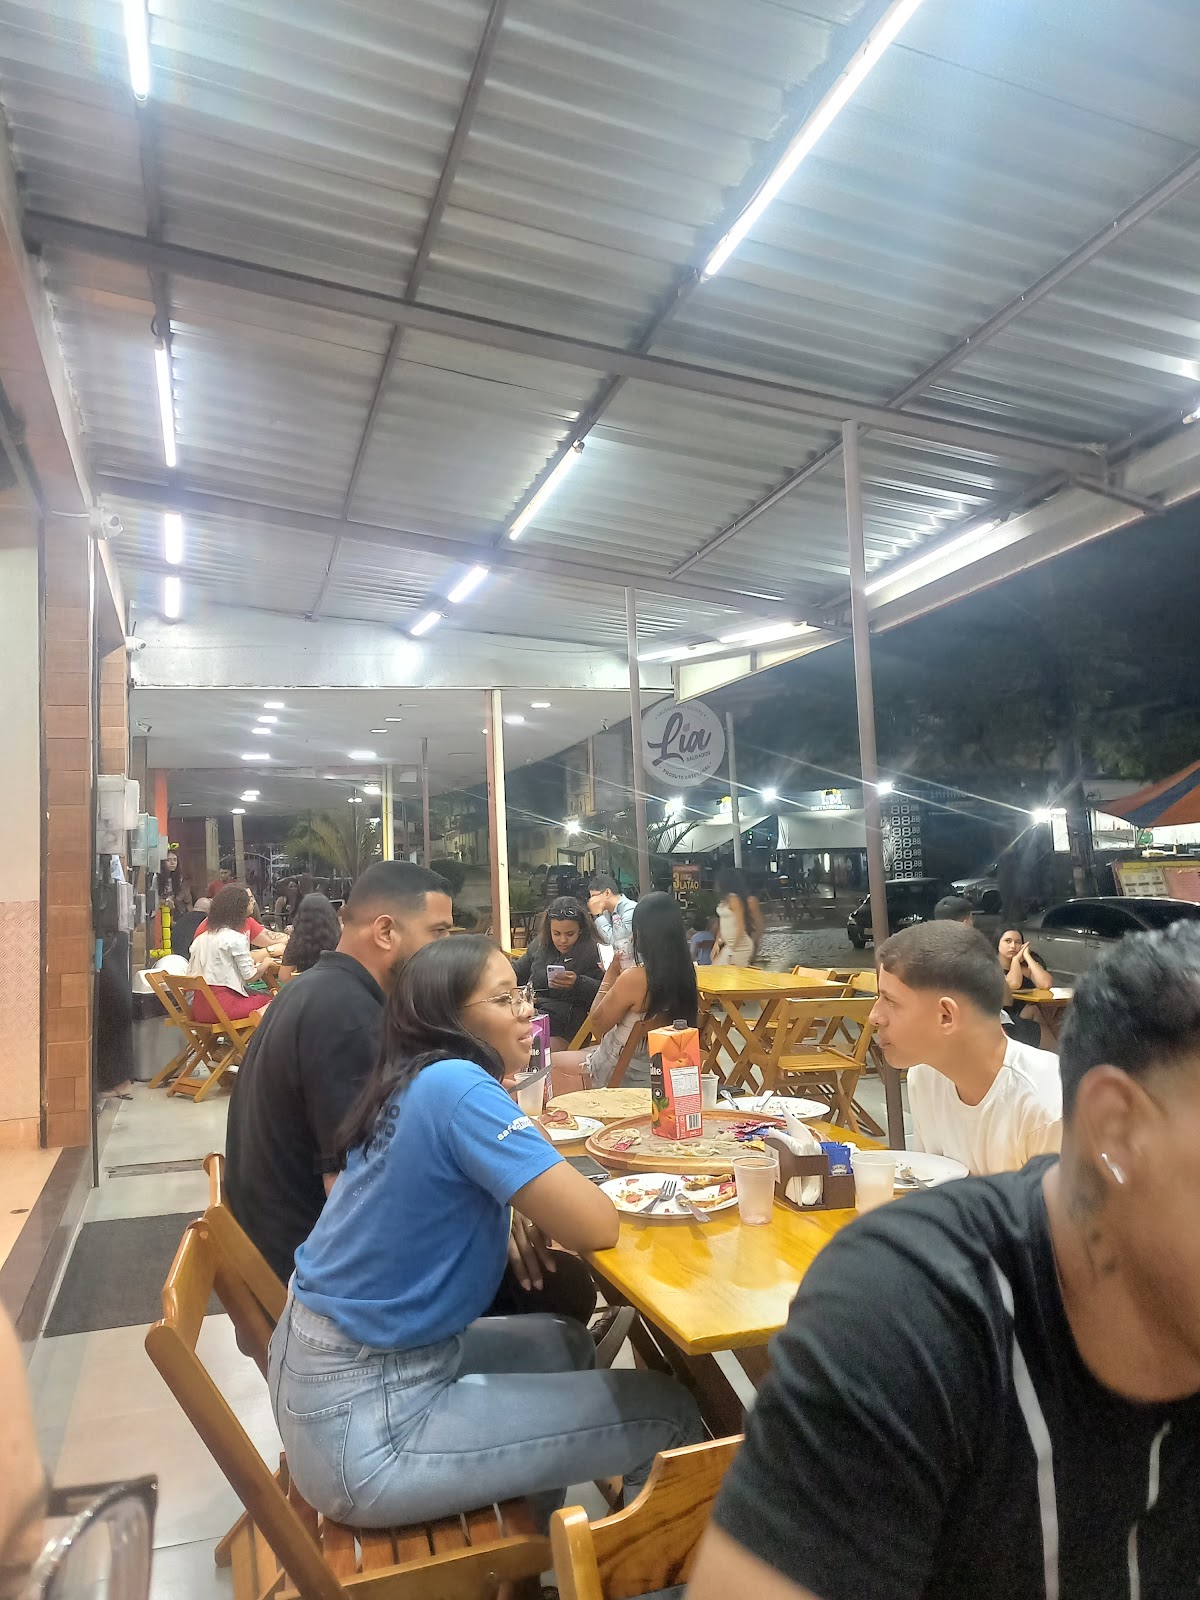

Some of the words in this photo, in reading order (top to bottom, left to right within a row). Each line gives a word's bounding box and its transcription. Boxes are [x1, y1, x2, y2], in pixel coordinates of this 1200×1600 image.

[647, 712, 712, 766] Lia
[673, 872, 680, 889] 3
[680, 880, 699, 890] LATÃO
